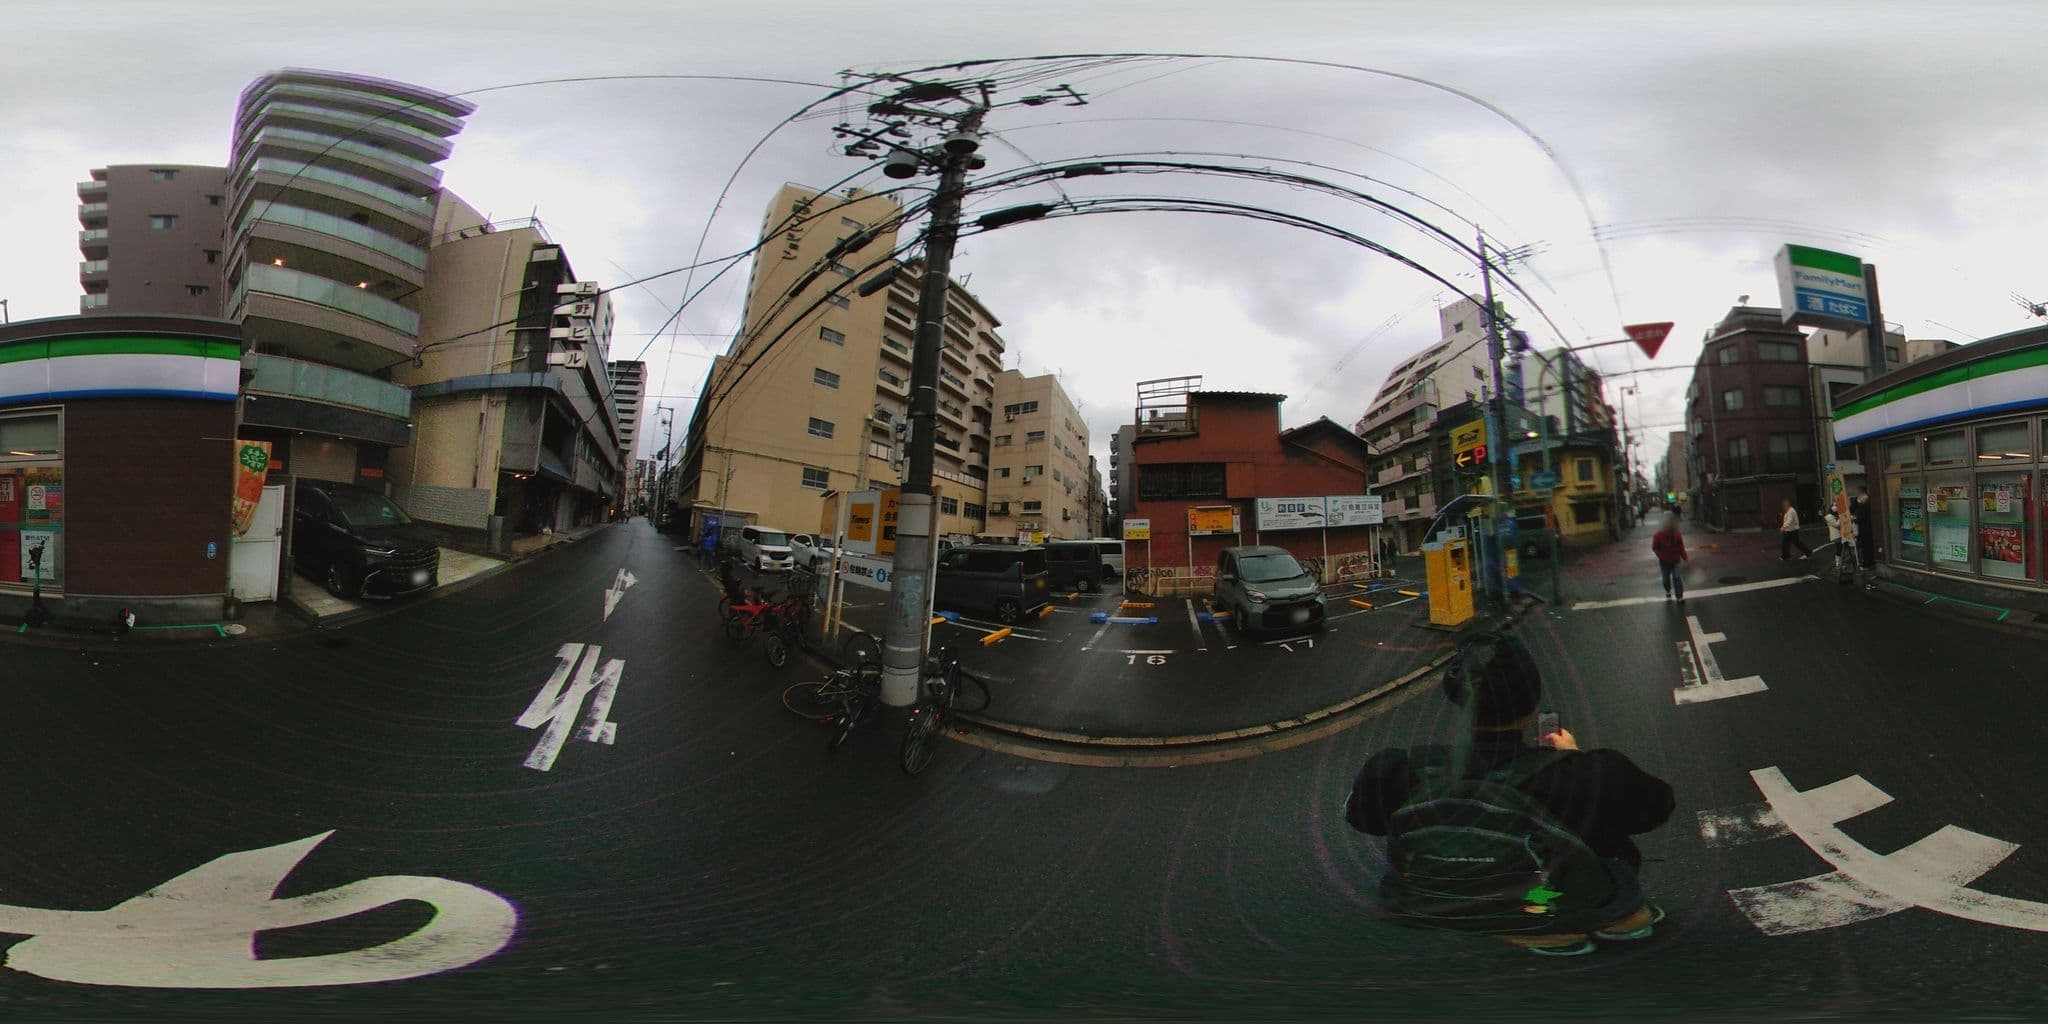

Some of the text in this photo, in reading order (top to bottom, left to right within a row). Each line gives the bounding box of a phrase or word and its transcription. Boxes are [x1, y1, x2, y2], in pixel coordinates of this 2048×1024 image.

[1795, 270, 1862, 290] FamilyMart
[1828, 301, 1859, 317] たばこ
[568, 283, 593, 364] 上野ビル
[1474, 445, 1487, 464] P
[1126, 655, 1167, 665] 16
